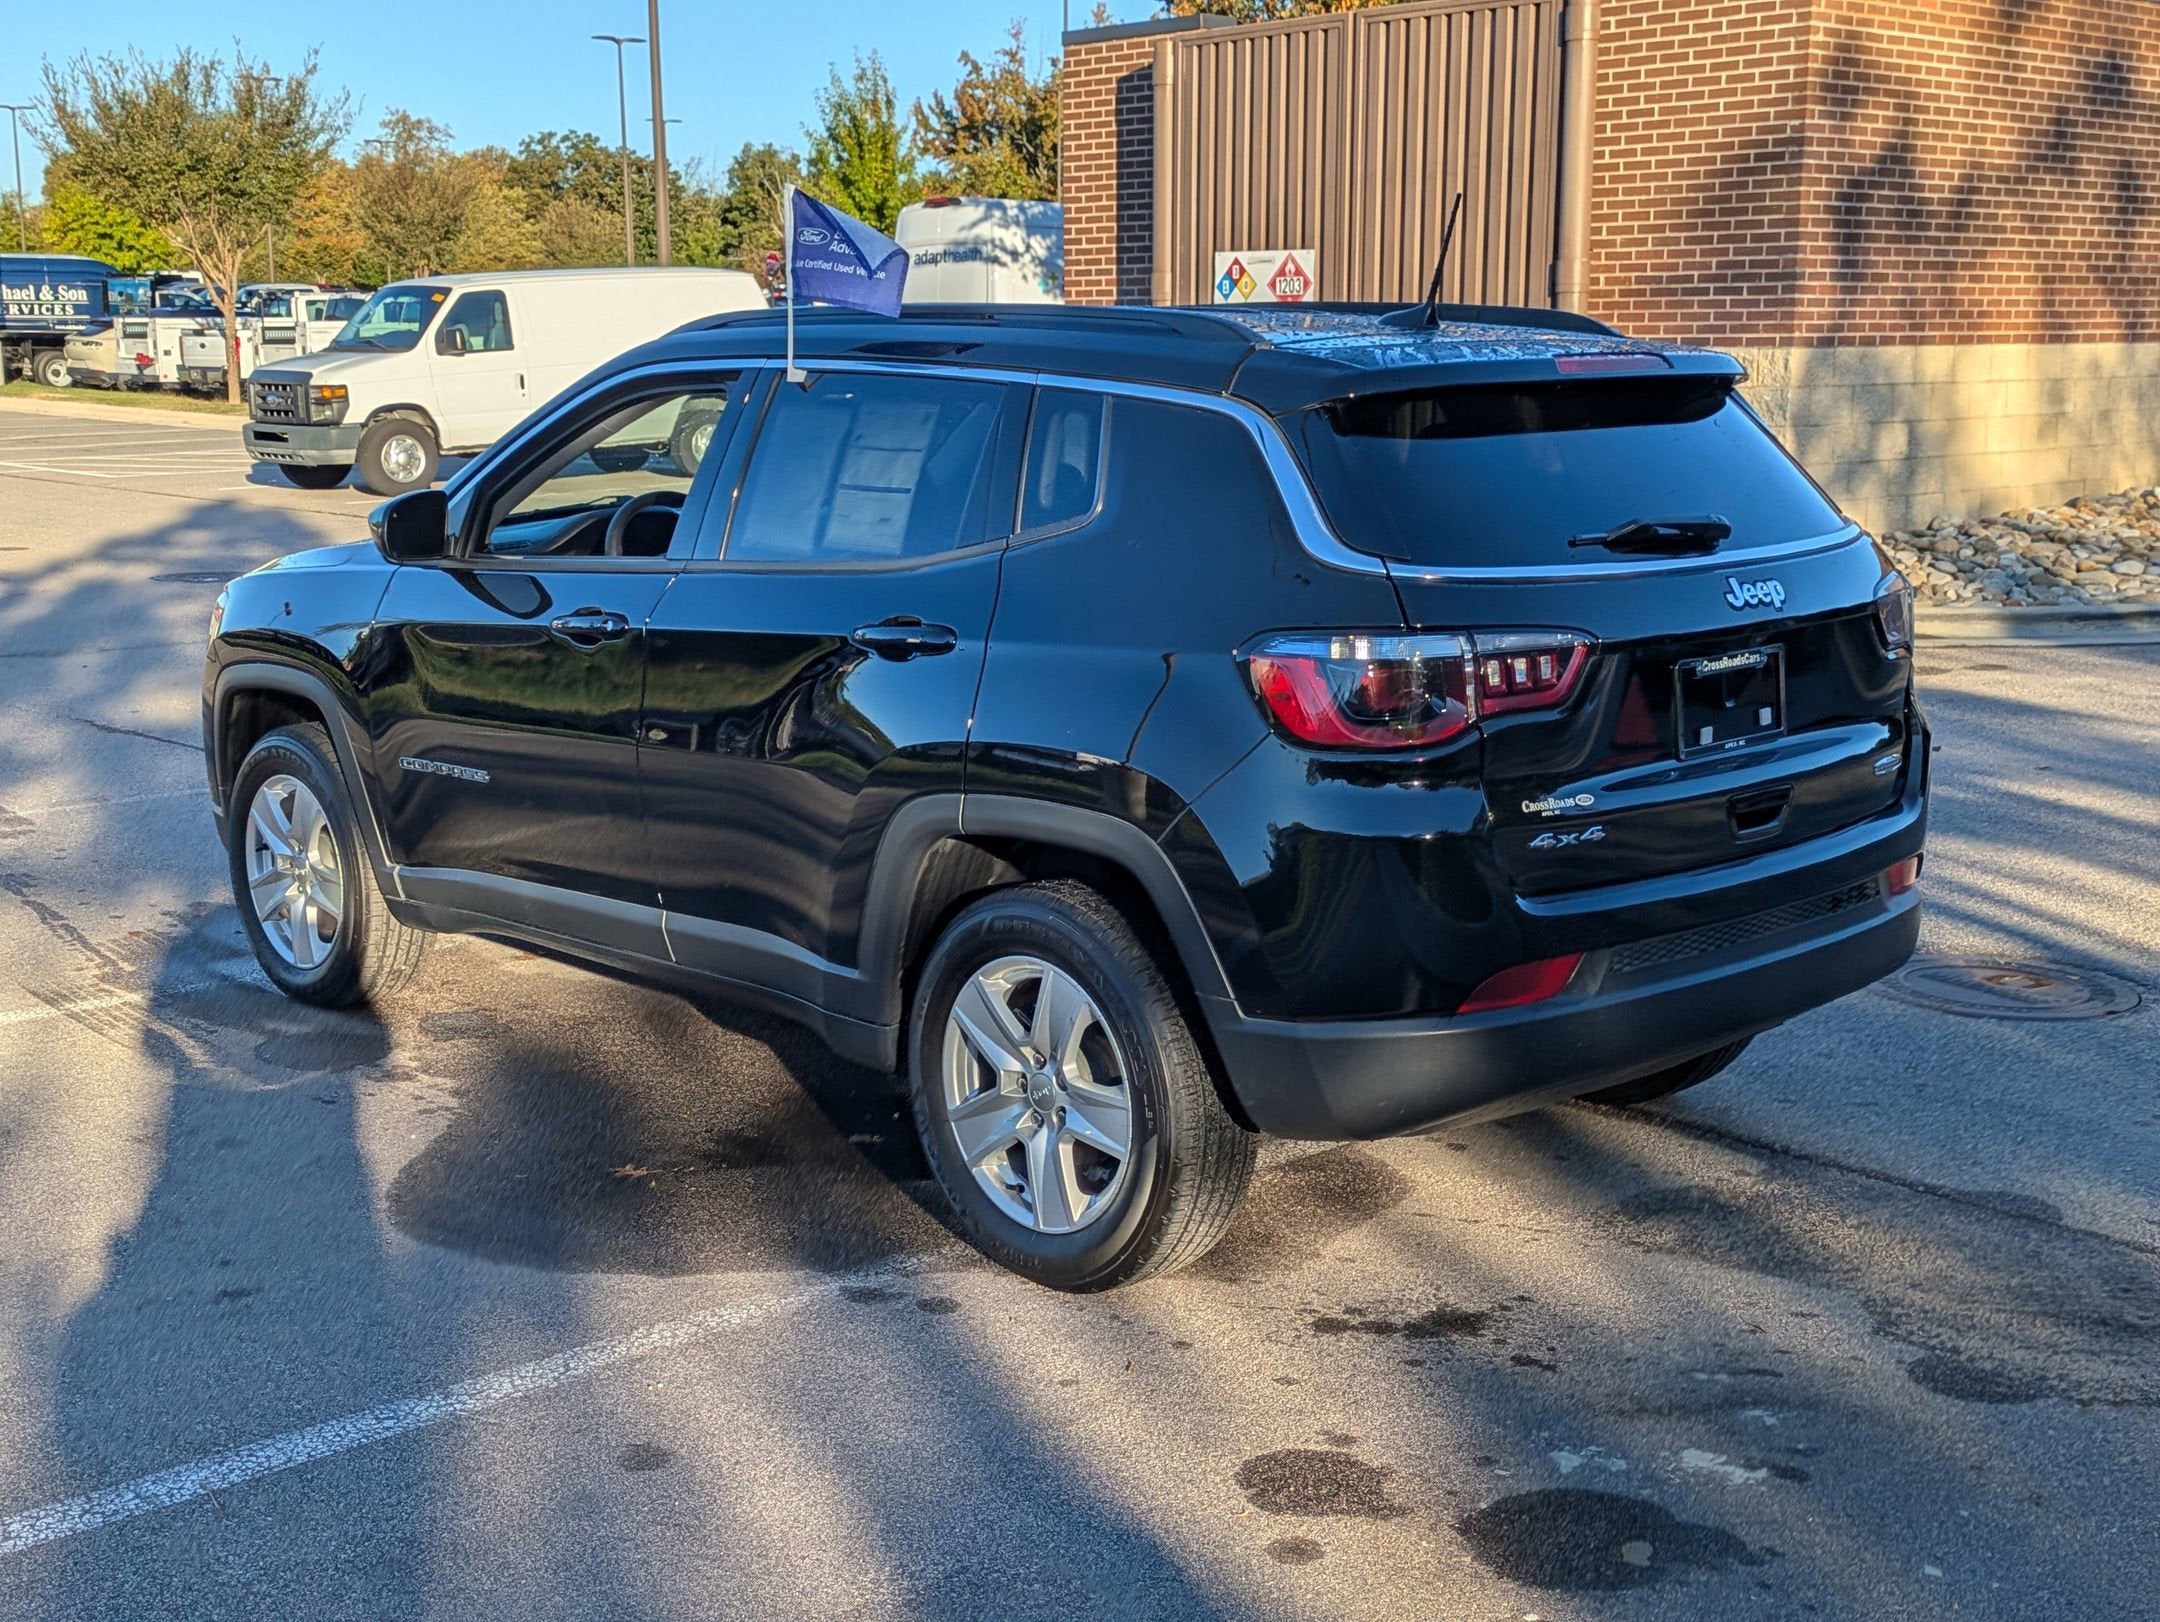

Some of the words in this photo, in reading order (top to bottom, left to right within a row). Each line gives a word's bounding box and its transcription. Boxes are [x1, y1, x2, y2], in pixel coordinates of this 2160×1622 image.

[914, 247, 982, 267] adapthealth
[834, 263, 854, 274] Used
[39, 284, 55, 301] &
[58, 284, 89, 301] Son
[1278, 278, 1302, 294] 1203
[1724, 577, 1786, 610] Jeep
[1702, 652, 1760, 672] CrossRoadsCars
[399, 757, 491, 784] COMPASS
